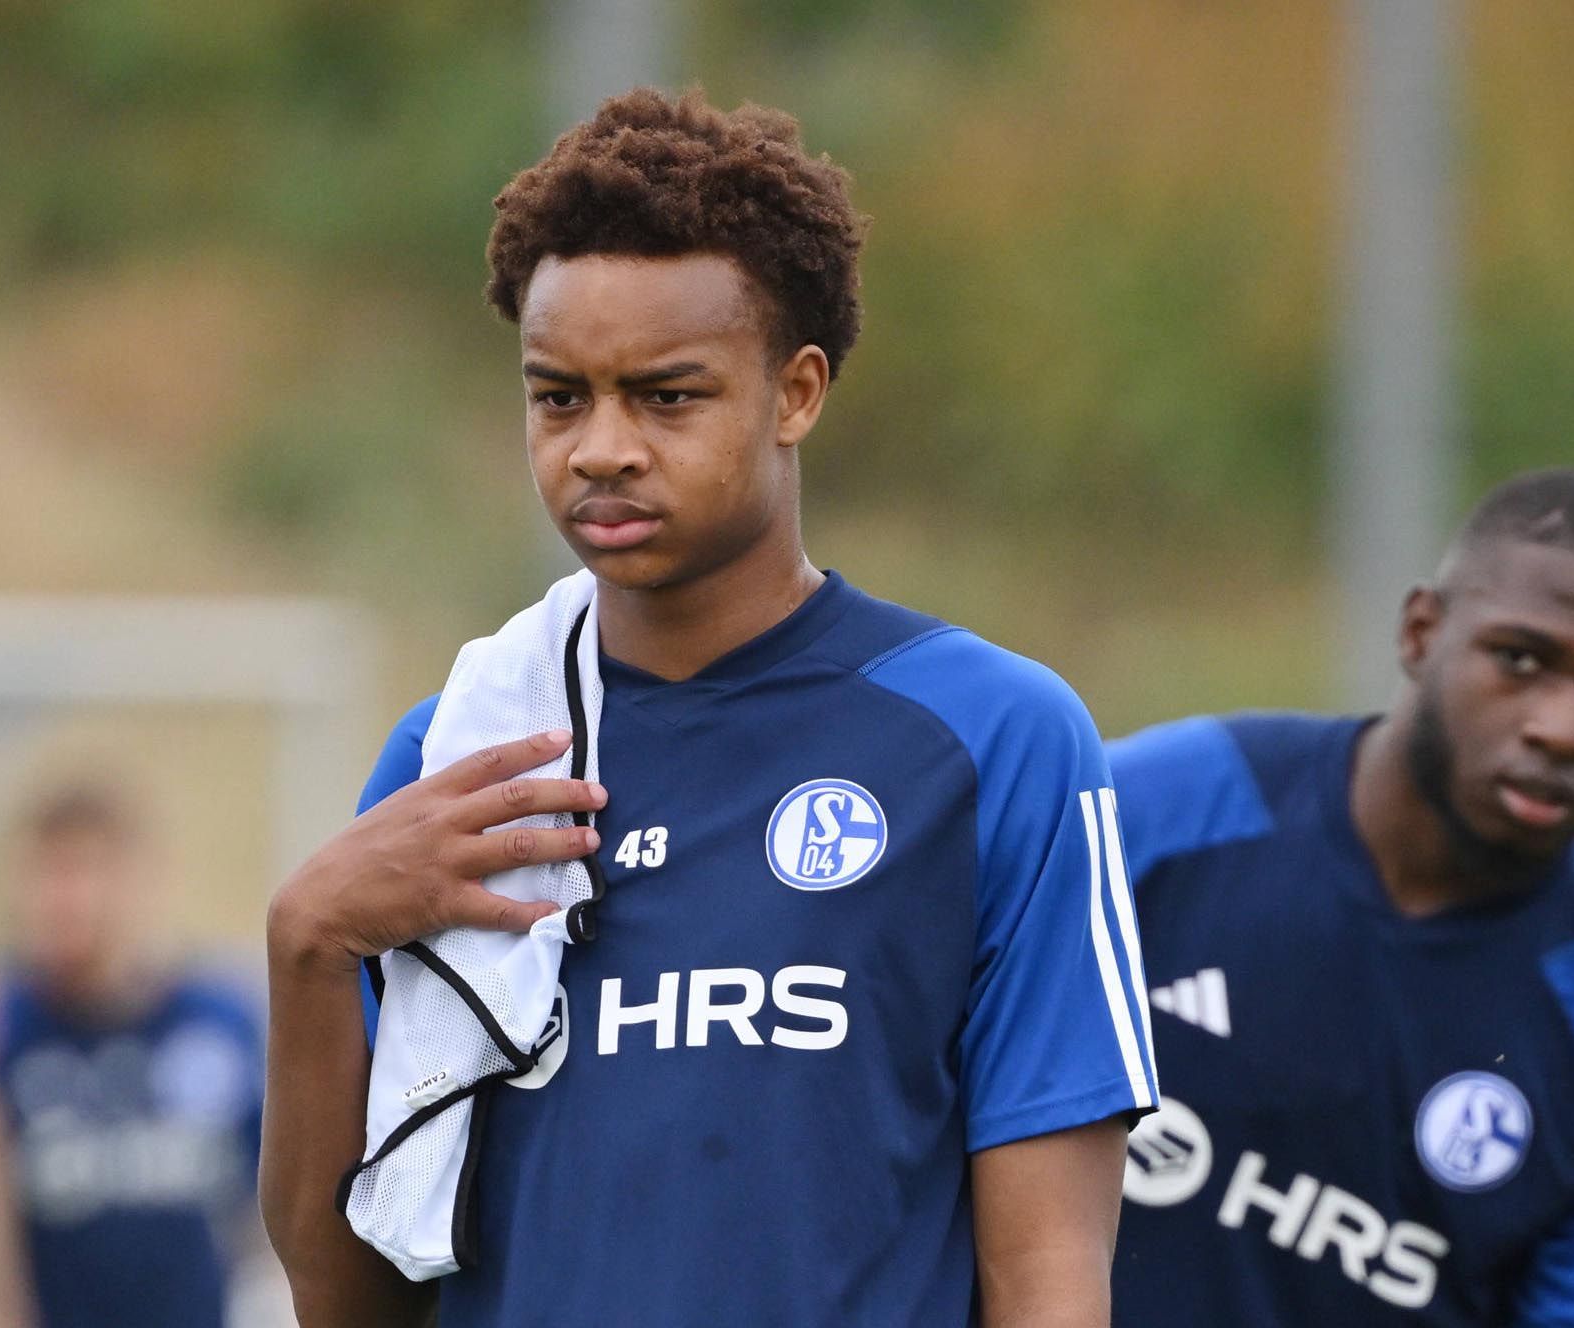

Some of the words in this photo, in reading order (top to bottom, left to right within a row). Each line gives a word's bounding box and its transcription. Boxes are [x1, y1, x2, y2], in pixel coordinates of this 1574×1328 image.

[614, 827, 669, 869] 43
[597, 966, 849, 1056] HRS
[404, 1071, 447, 1098] CAWILA
[1217, 1151, 1450, 1308] HRS
